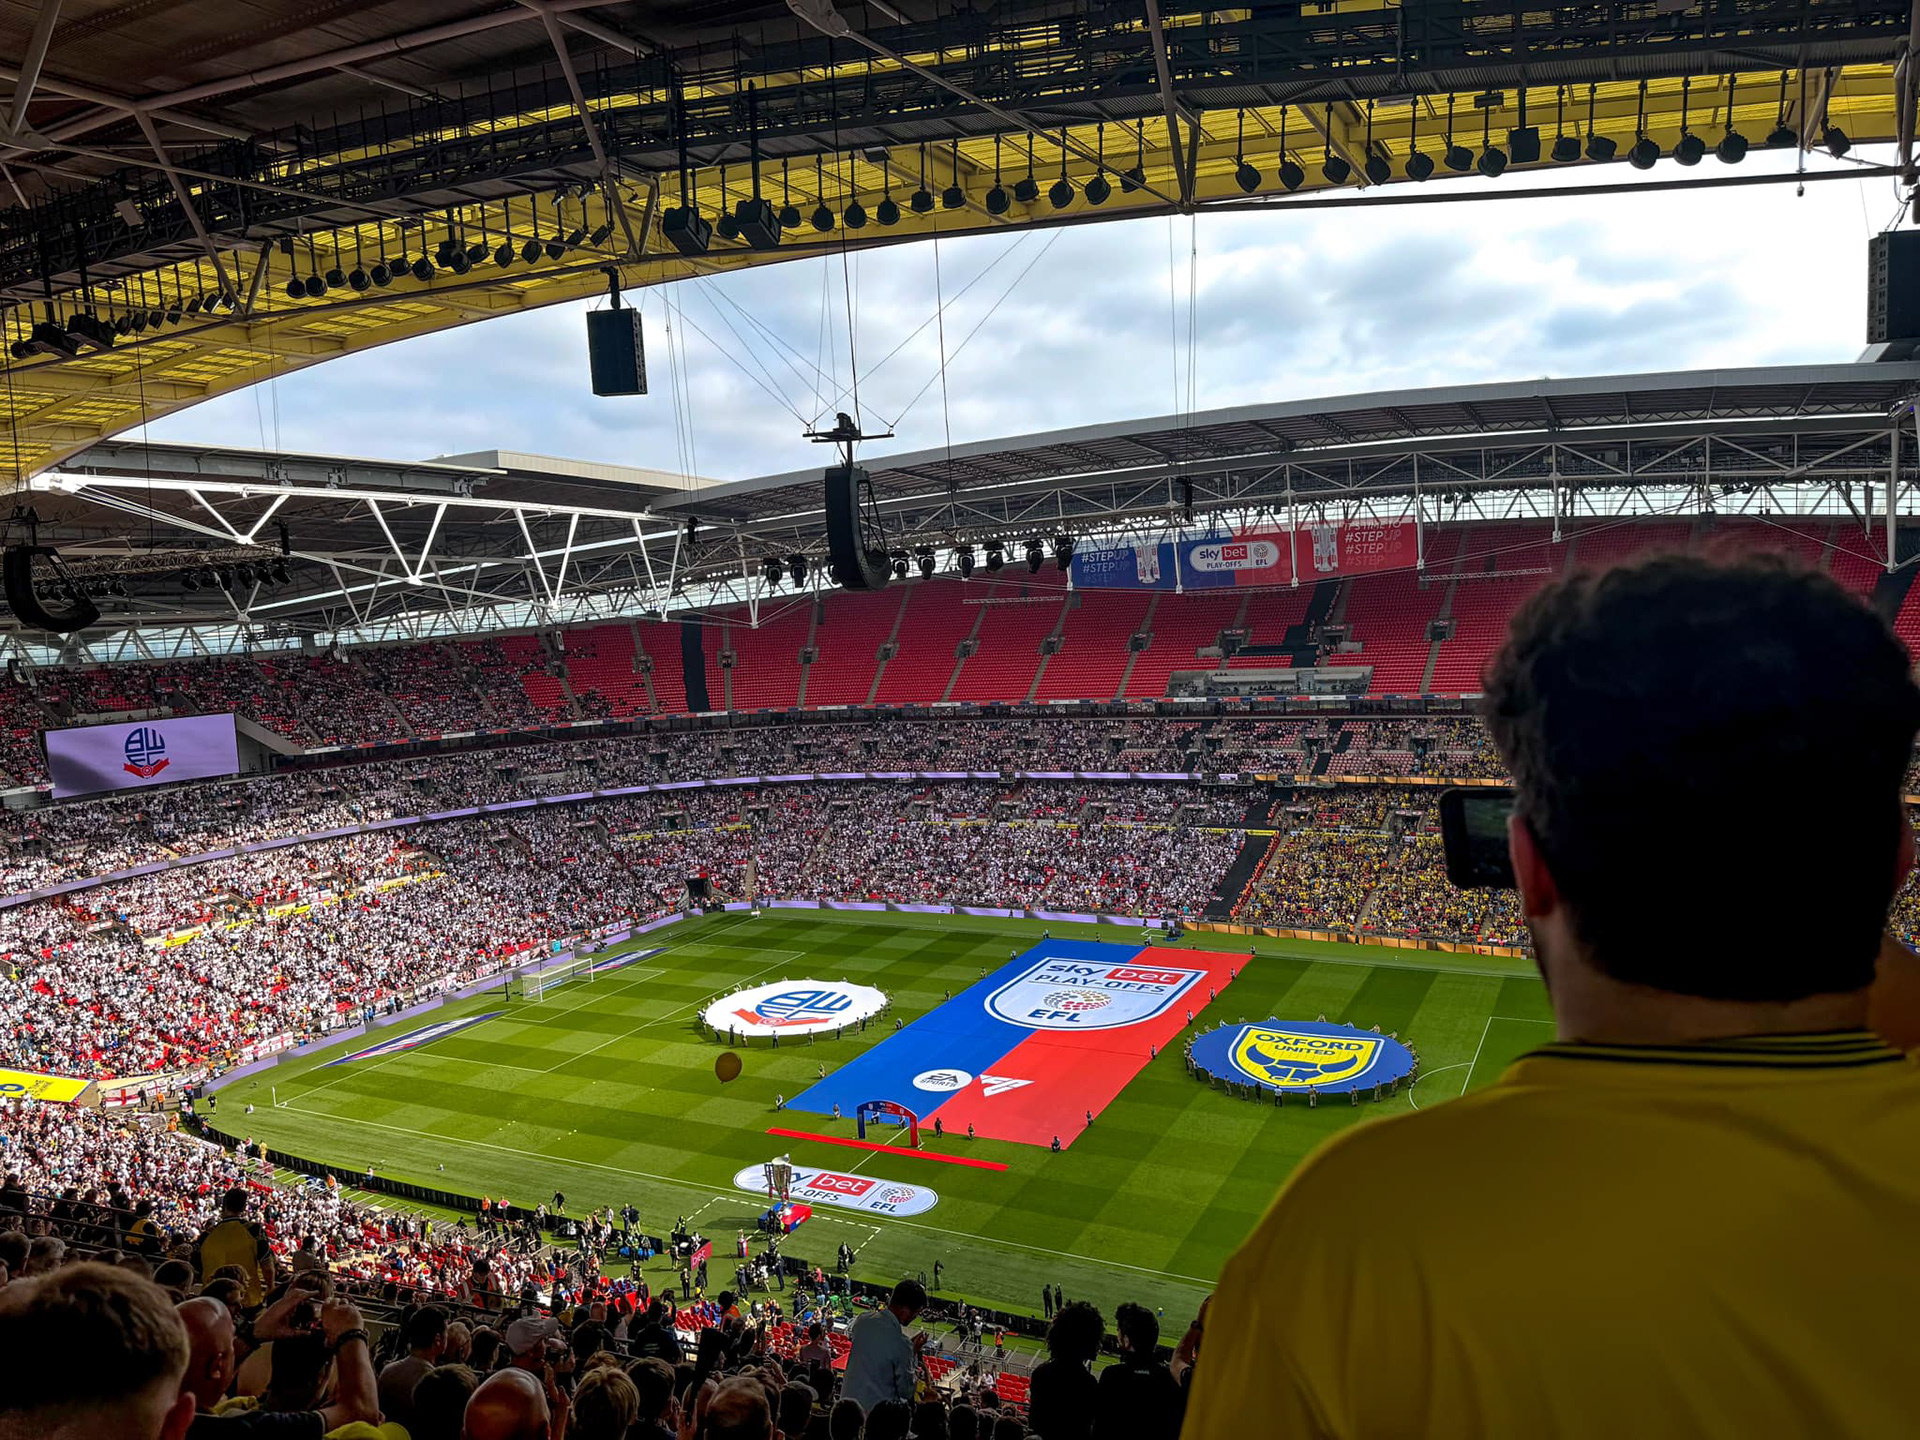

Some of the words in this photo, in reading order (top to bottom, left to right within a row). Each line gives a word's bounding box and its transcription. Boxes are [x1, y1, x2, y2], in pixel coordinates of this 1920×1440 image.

[1199, 548, 1220, 560] sky
[1223, 547, 1246, 558] bet
[1206, 561, 1242, 570] PLAY-OFFS
[1046, 964, 1105, 977] sky
[1114, 968, 1175, 983] bet
[1034, 974, 1168, 993] PLAY-OFFS
[1027, 1008, 1081, 1023] EFL
[1255, 1033, 1364, 1051] OXFORD
[1274, 1044, 1336, 1056] UNITED
[817, 1174, 867, 1193] bet
[869, 1201, 897, 1213] EFL
